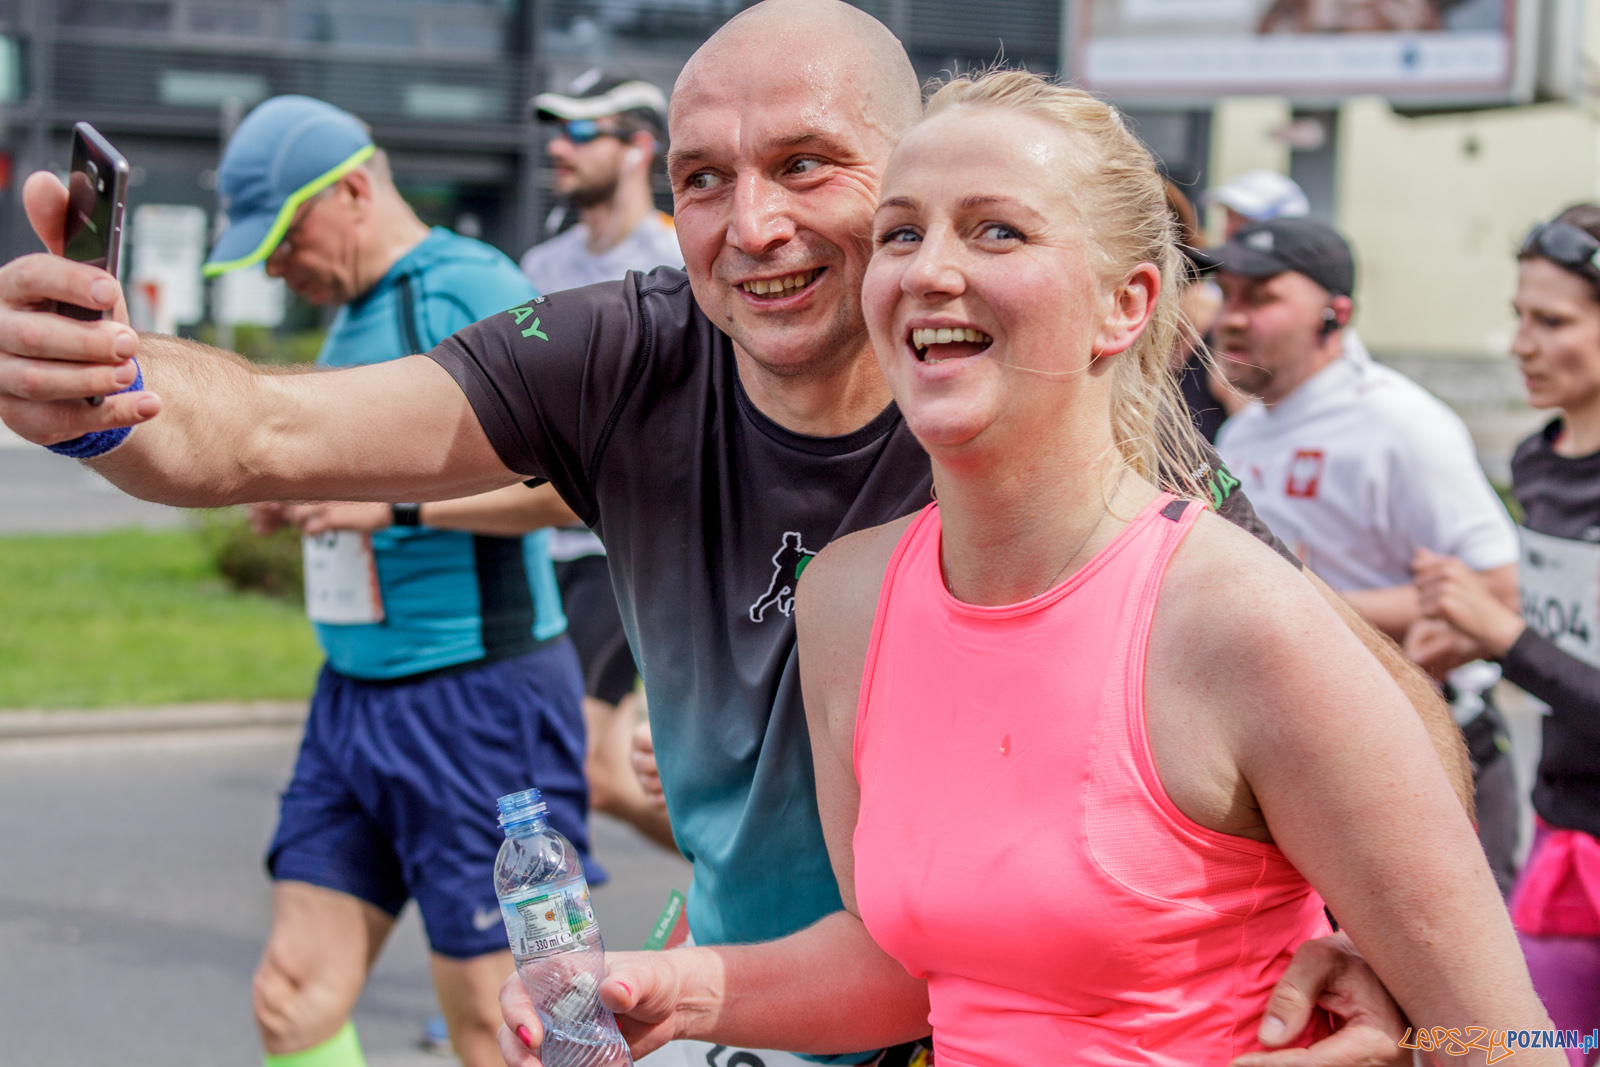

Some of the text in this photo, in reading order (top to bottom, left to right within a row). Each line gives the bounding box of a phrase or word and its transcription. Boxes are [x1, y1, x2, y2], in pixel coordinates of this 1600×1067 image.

[507, 301, 549, 342] AY
[535, 938, 549, 951] 330
[550, 935, 560, 948] ml
